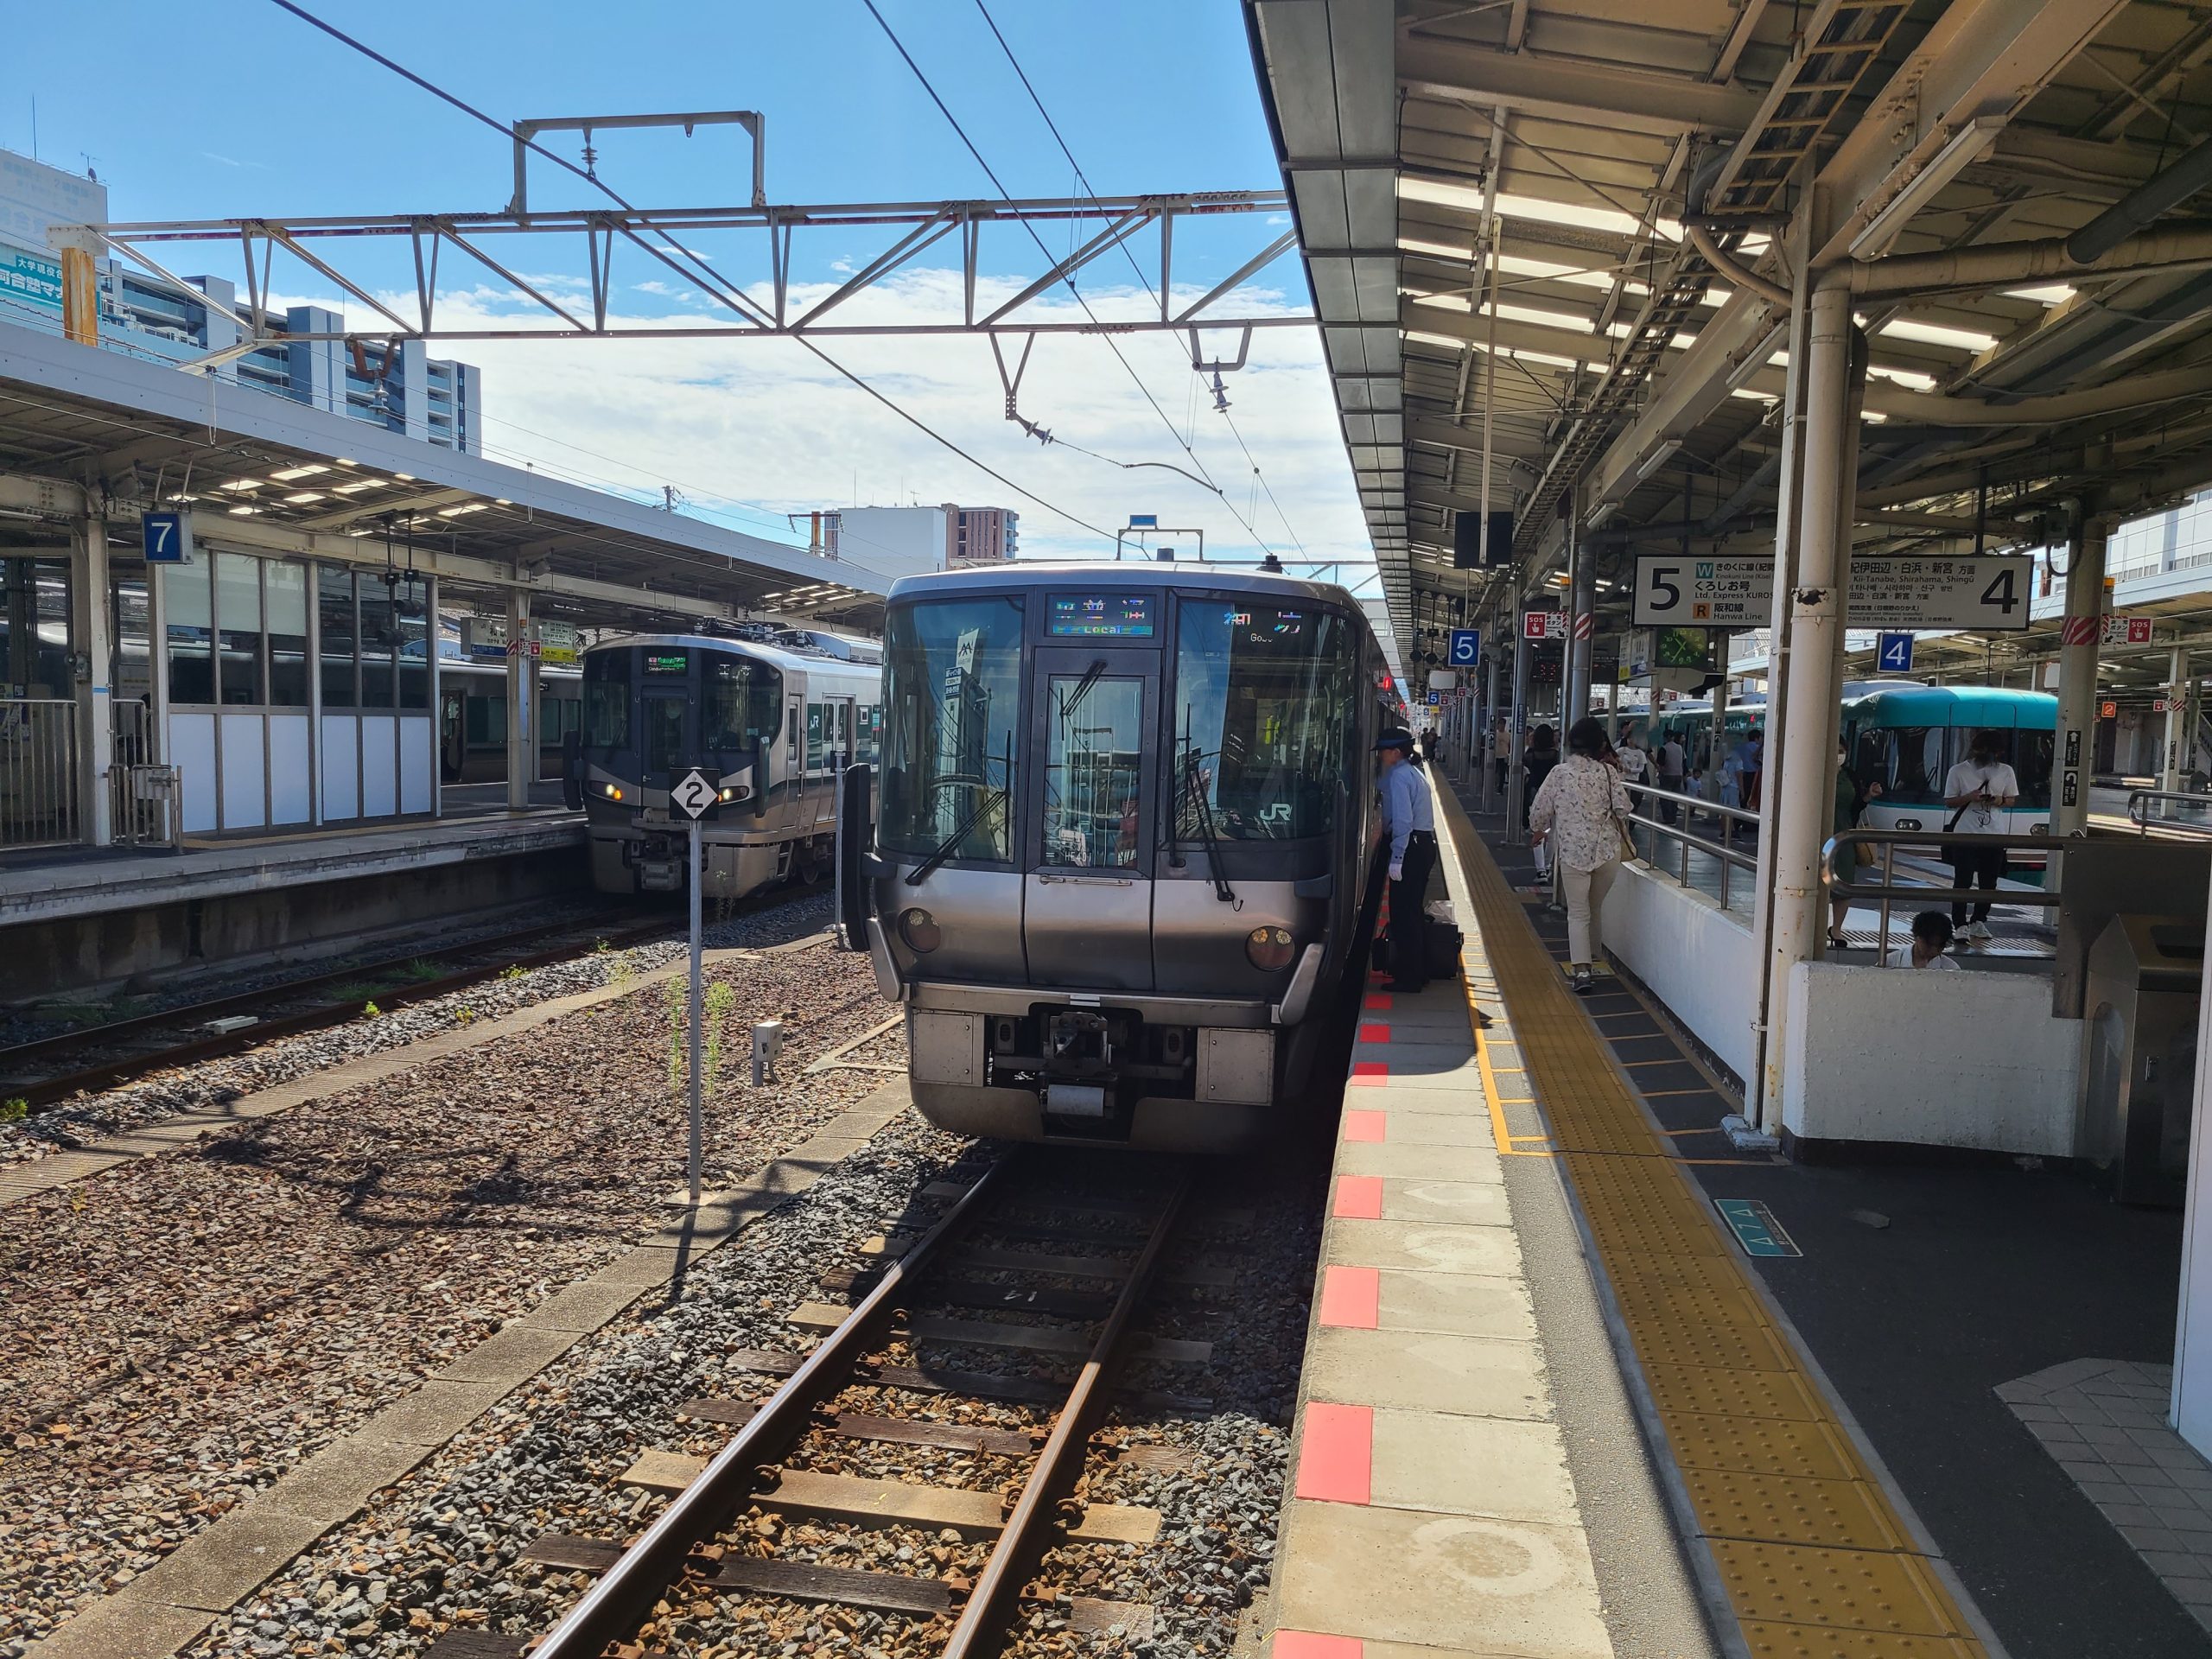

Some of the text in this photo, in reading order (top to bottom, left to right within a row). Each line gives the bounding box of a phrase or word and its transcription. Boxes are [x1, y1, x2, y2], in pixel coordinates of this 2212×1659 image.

[152, 523, 173, 552] 7
[1697, 563, 1713, 576] W
[1958, 565, 1975, 575] 方面
[1853, 575, 1897, 583] Kii-Tanabe,
[1649, 568, 1680, 611] 5
[1694, 581, 1750, 591] くろしお号
[1980, 569, 2018, 614] 4
[1696, 605, 1707, 617] R
[1713, 603, 1744, 613] 阪和線
[1456, 636, 1473, 660] 5
[1885, 641, 1905, 665] 4
[1430, 694, 1437, 703] 5
[2105, 704, 2113, 715] 2
[810, 715, 819, 728] JR
[686, 782, 703, 808] 2
[1260, 804, 1290, 820] JR
